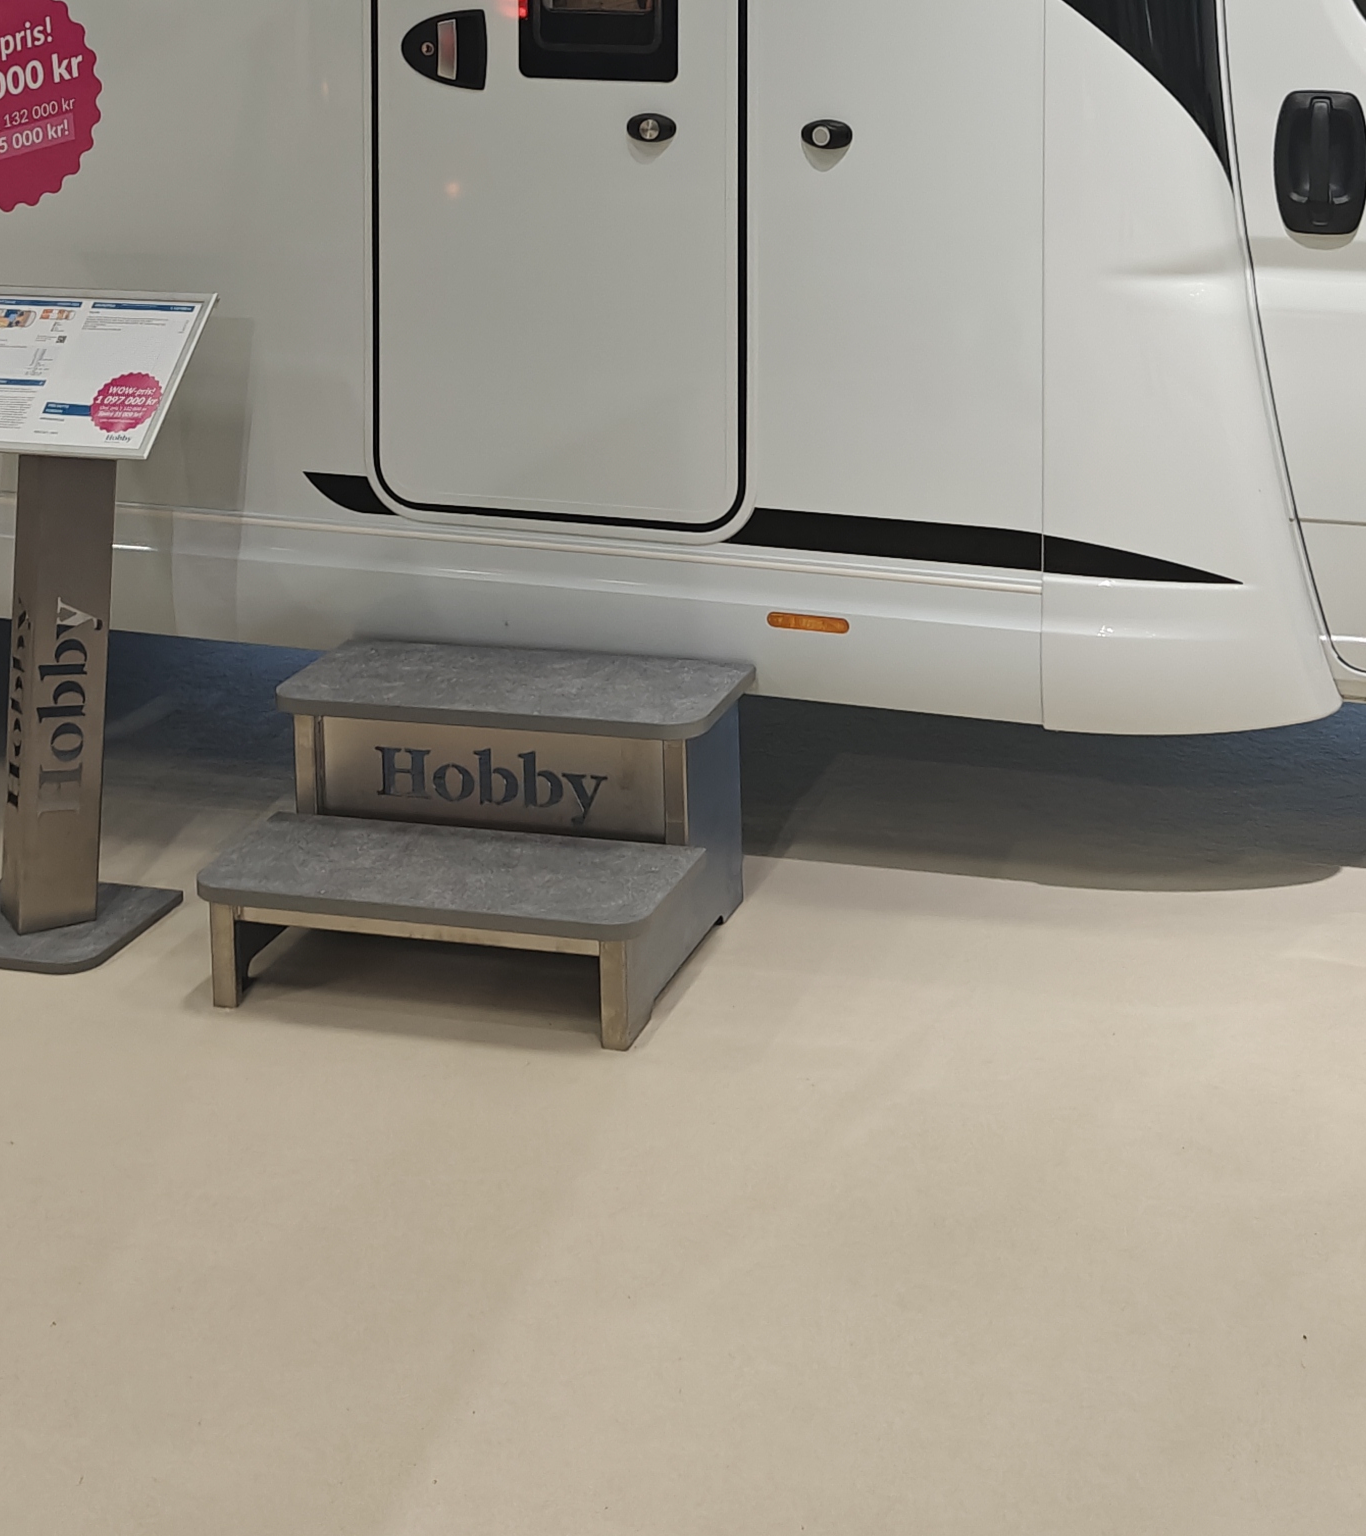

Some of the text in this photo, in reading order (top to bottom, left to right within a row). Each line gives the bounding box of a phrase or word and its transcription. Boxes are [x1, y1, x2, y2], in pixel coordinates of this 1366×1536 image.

[51, 53, 83, 83] kr
[4, 109, 29, 127] 132
[32, 102, 58, 120] 000
[61, 97, 75, 111] kr
[12, 126, 43, 149] 000
[47, 119, 69, 140] kr!
[95, 396, 158, 405] 1 097 000 kr
[36, 596, 103, 818] Hobby
[375, 746, 608, 826] Hobby
